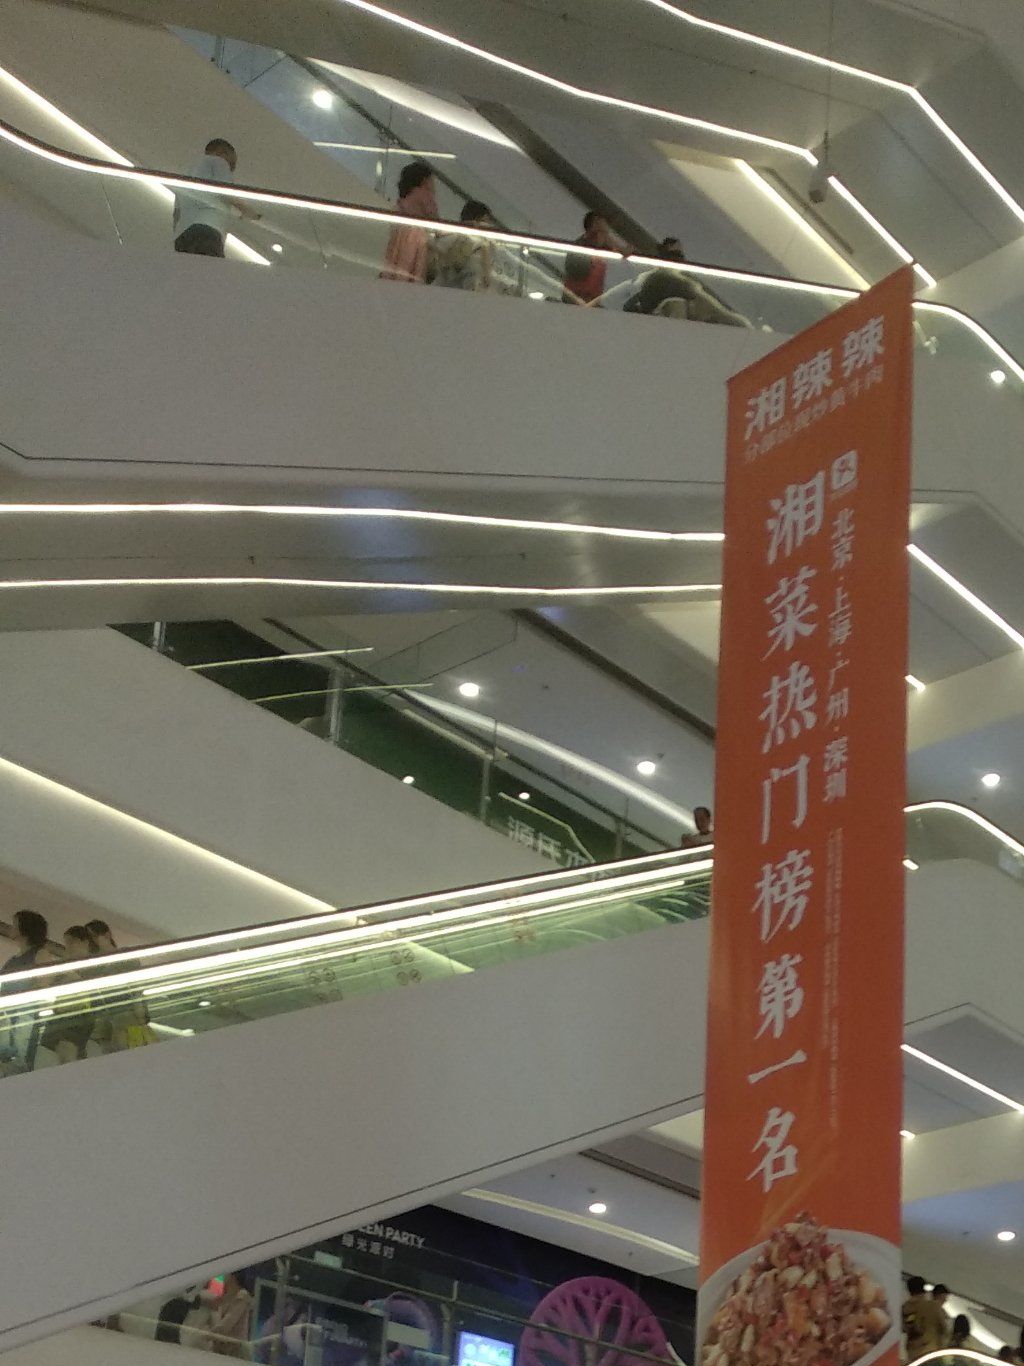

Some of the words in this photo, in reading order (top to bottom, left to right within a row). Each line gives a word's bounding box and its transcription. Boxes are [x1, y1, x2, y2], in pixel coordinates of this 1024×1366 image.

[744, 315, 885, 441] 湘辣辣
[745, 469, 826, 1193] 湘菜热门榜第一名
[385, 1226, 426, 1248] PARTY
